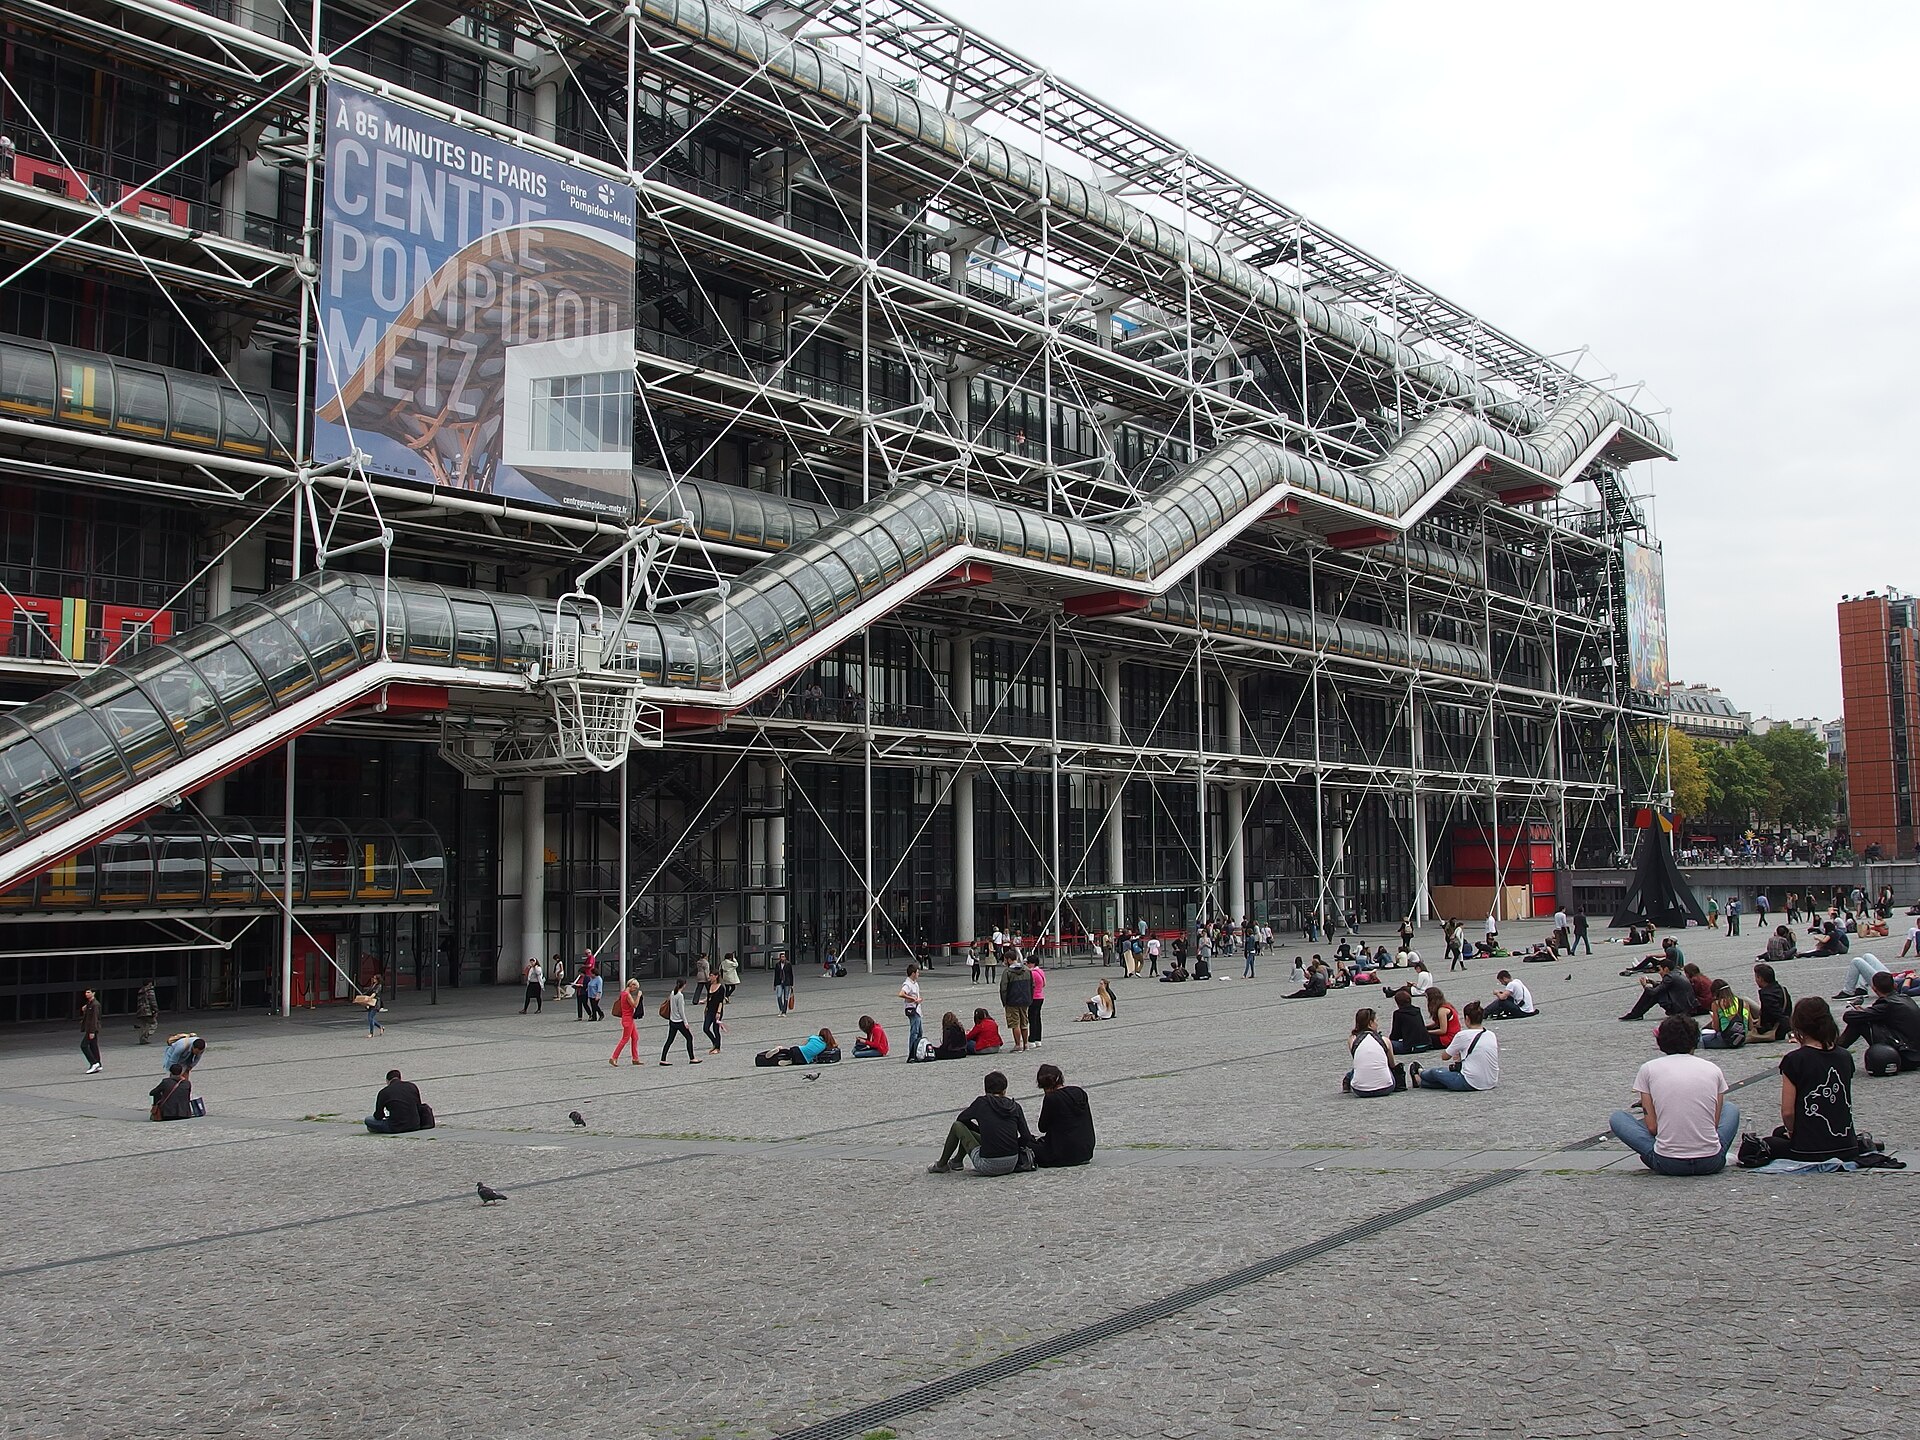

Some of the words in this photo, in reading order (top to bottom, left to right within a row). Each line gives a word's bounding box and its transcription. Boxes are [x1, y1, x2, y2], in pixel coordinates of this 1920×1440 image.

[336, 98, 349, 131] À
[355, 110, 379, 140] 85
[384, 120, 466, 171] MINUTES
[471, 151, 493, 181] DE
[498, 160, 547, 198] PARIS
[333, 138, 547, 273] CENTRE
[560, 179, 587, 198] Centre
[570, 196, 632, 227] Pompidou-Metz
[326, 308, 478, 416] METZ
[562, 496, 628, 514] centrepompidou-metz.fr
